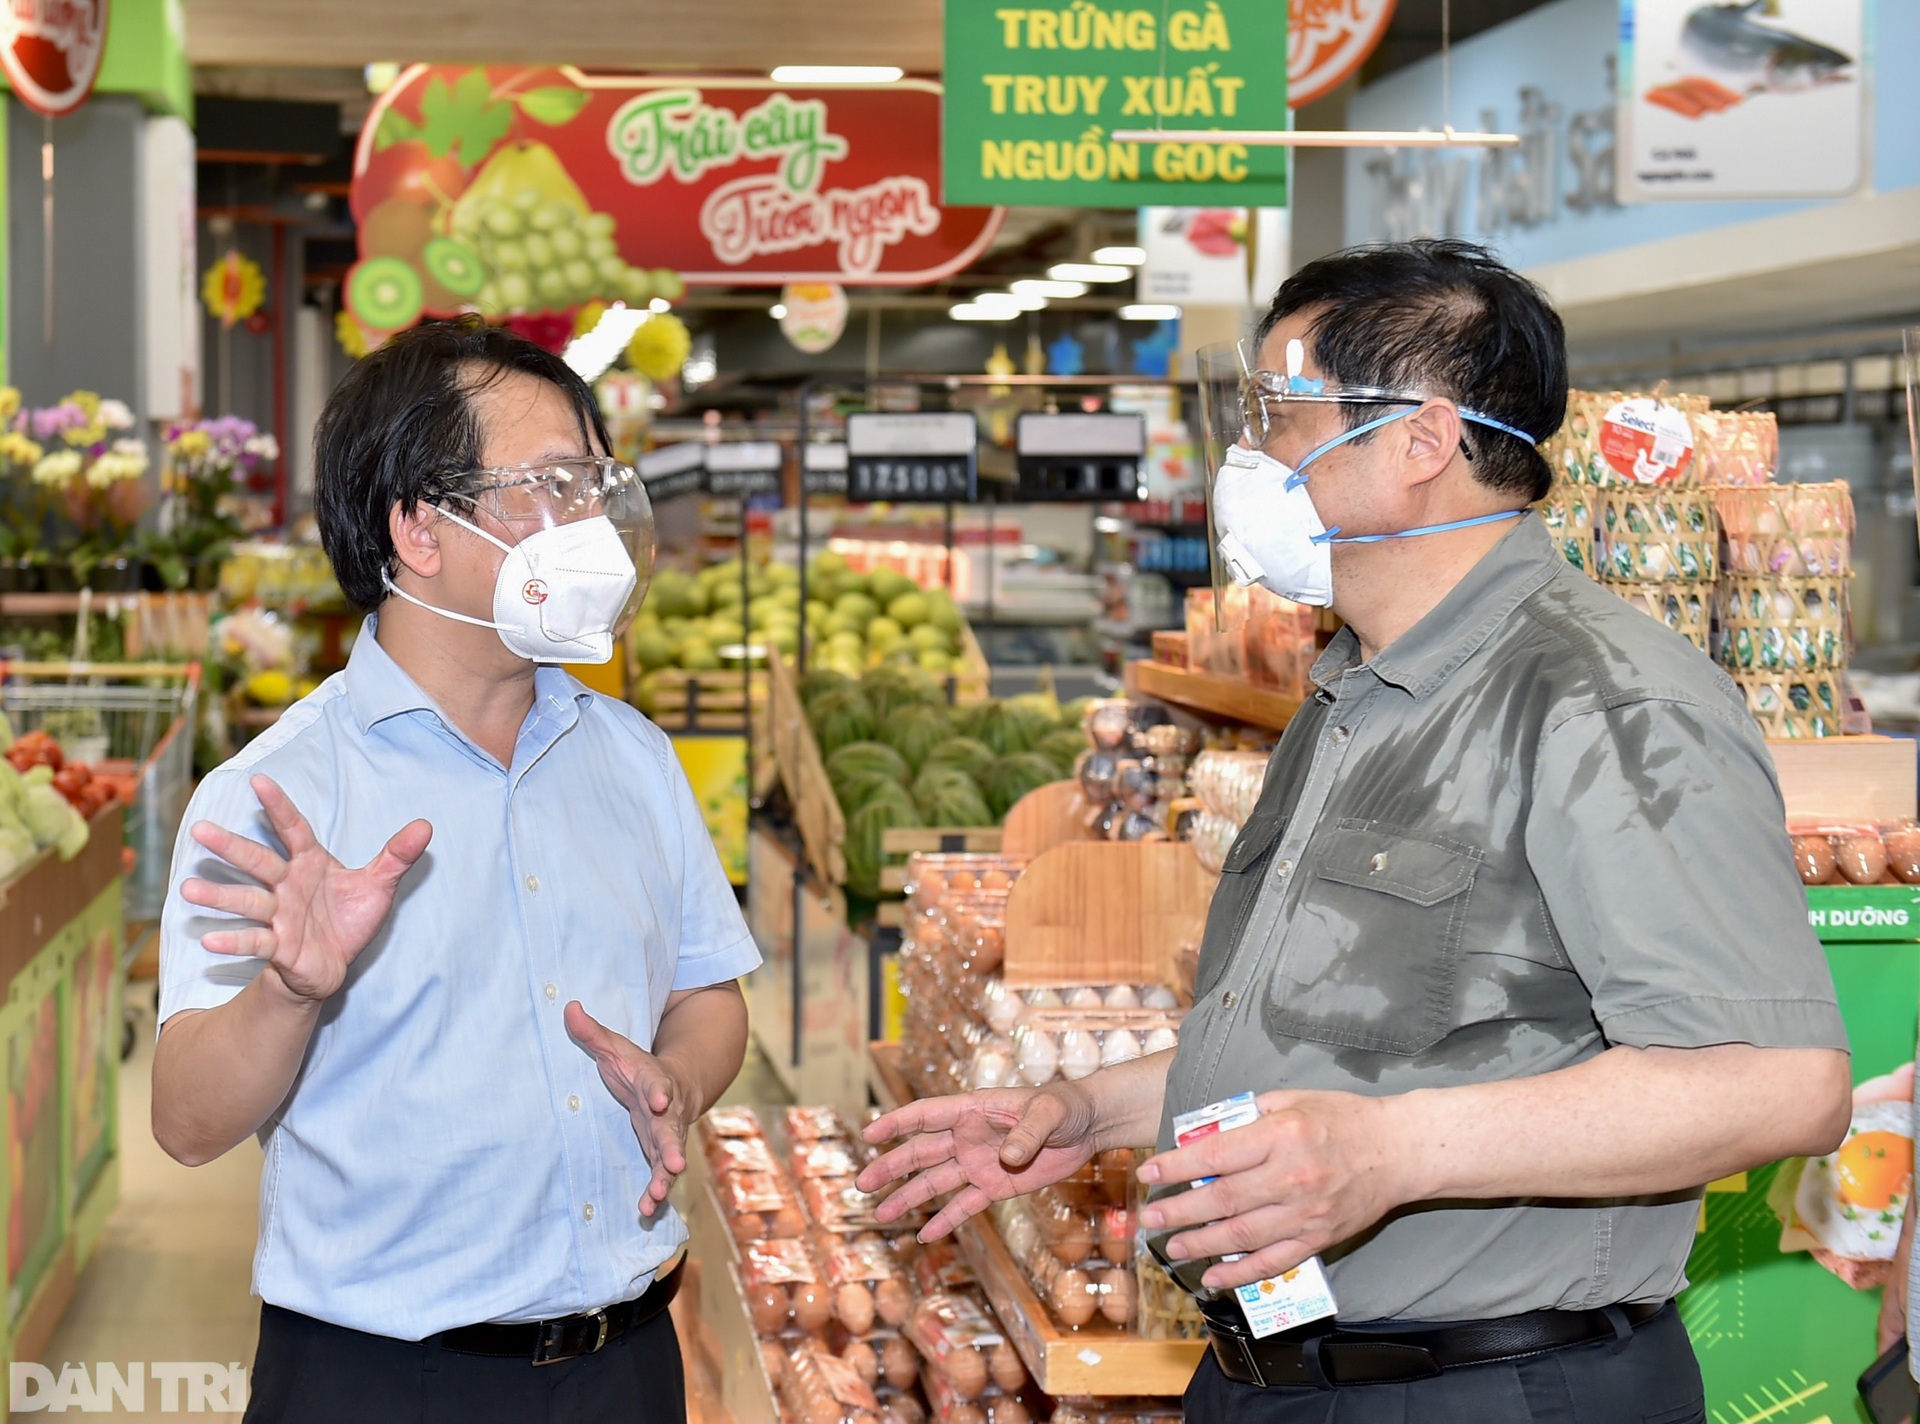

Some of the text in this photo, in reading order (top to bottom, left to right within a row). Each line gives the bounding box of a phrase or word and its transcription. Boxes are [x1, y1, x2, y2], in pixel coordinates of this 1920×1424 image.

[995, 0, 1157, 51] TRỨNG
[1167, 1, 1231, 51] GÀ
[981, 62, 1245, 117] TRUY XUẤT
[611, 94, 842, 193] Trái cây
[981, 125, 1140, 181] NGUỒN
[1619, 411, 1656, 433] Select
[1830, 905, 1910, 927] DƯỠNG
